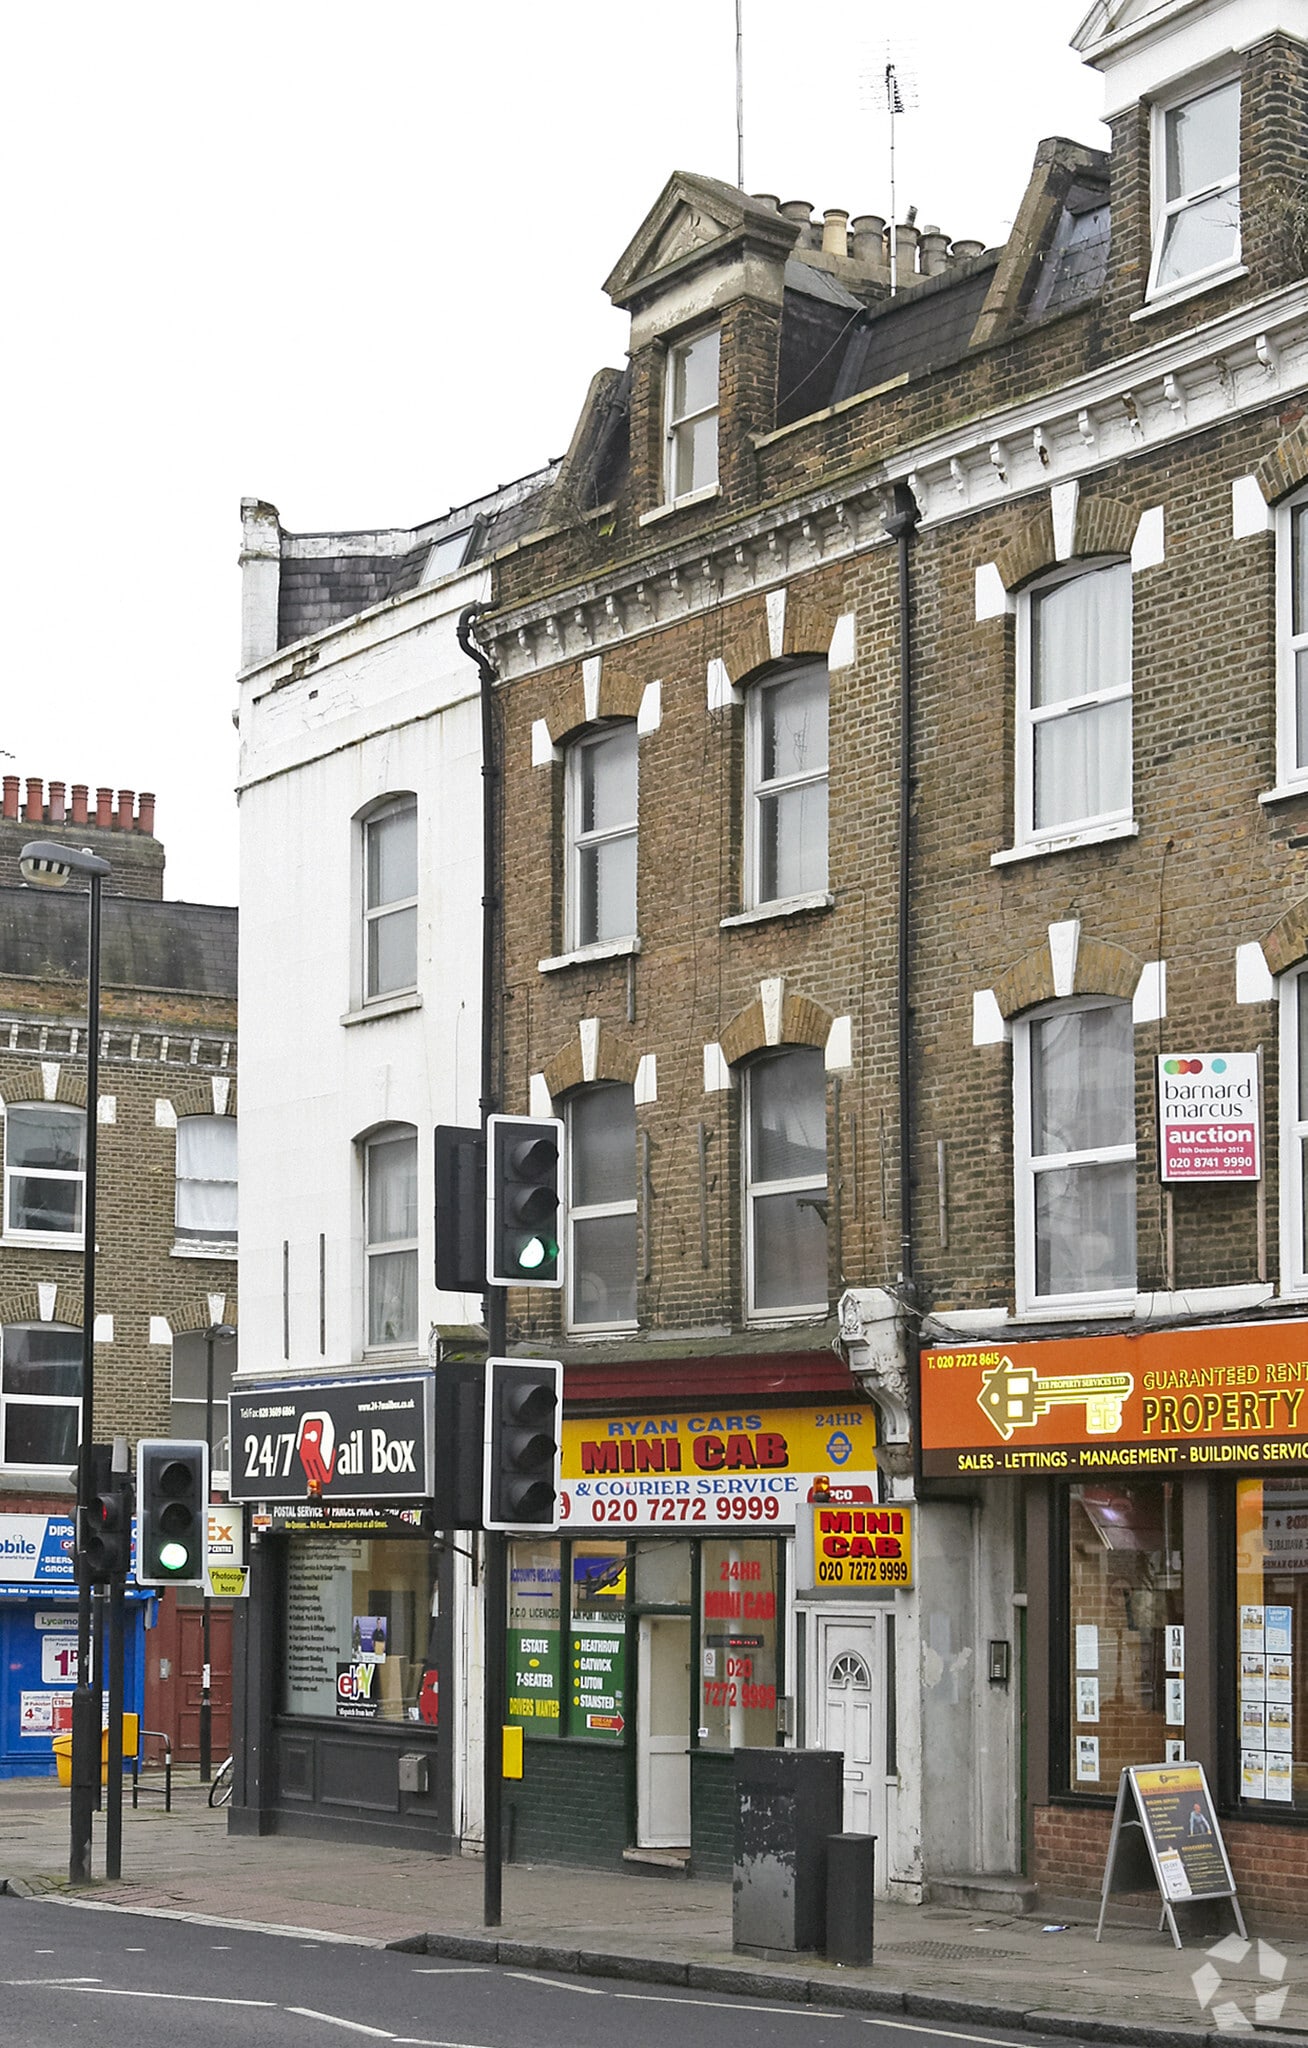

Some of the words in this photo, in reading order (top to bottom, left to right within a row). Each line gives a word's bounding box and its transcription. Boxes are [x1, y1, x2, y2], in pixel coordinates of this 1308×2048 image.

[1165, 1078, 1251, 1100] barnard
[1166, 1103, 1243, 1118] marcus
[1168, 1125, 1252, 1144] auction
[1169, 1157, 1190, 1168] 020
[1194, 1157, 1219, 1168] 8741
[1223, 1156, 1252, 1167] 9990
[937, 1356, 953, 1369] 020
[956, 1353, 977, 1368] 7272
[979, 1352, 1000, 1366] 8615
[1050, 1379, 1081, 1389] PROPERTY
[1082, 1377, 1112, 1388] SERVICES
[1112, 1376, 1126, 1386] LTD
[1143, 1364, 1260, 1391] GUARANTEED
[815, 1412, 862, 1427] 24HR
[1142, 1388, 1305, 1434] PROPERTY
[608, 1420, 678, 1436] RYAN
[687, 1414, 762, 1433] CARS
[244, 1434, 296, 1477] 24/7
[371, 1429, 416, 1473] Box
[581, 1438, 682, 1473] MINI
[693, 1432, 789, 1471] CAB
[958, 1454, 994, 1470] SALES
[1004, 1451, 1068, 1469] LETTINGS
[1079, 1447, 1178, 1466] MANAGEMENT
[1189, 1443, 1260, 1463] BUILDING
[575, 1482, 591, 1497] &
[595, 1480, 690, 1497] COURIER
[697, 1477, 799, 1494] SERVICE
[274, 1506, 296, 1518] POSTAL
[297, 1506, 324, 1518] SERVICE
[592, 1499, 638, 1522] 020
[647, 1498, 706, 1521] 7272
[716, 1496, 780, 1520] 9999
[819, 1511, 904, 1535] MINI
[822, 1536, 902, 1559] CAB
[212, 1571, 245, 1582] Photocopy
[719, 1561, 761, 1581] 24HR
[819, 1562, 843, 1581] 020
[849, 1562, 877, 1581] 7272
[880, 1562, 907, 1581] 9999
[221, 1584, 236, 1592] here
[704, 1591, 741, 1619] MINI
[743, 1591, 776, 1620] CAB
[42, 1617, 78, 1626] Lycamo
[521, 1638, 549, 1653] ESTATE
[580, 1639, 619, 1654] HEATHROW
[580, 1657, 612, 1672] GATWICK
[726, 1657, 752, 1678] 020
[516, 1672, 553, 1688] 7-SEATER
[580, 1675, 603, 1690] LUTON
[580, 1694, 614, 1709] STANSTED
[704, 1681, 737, 1707] 7272
[741, 1683, 776, 1710] 9999
[25, 1708, 34, 1719] 4
[509, 1697, 534, 1716] DRIVERS
[535, 1698, 560, 1718] WANTED
